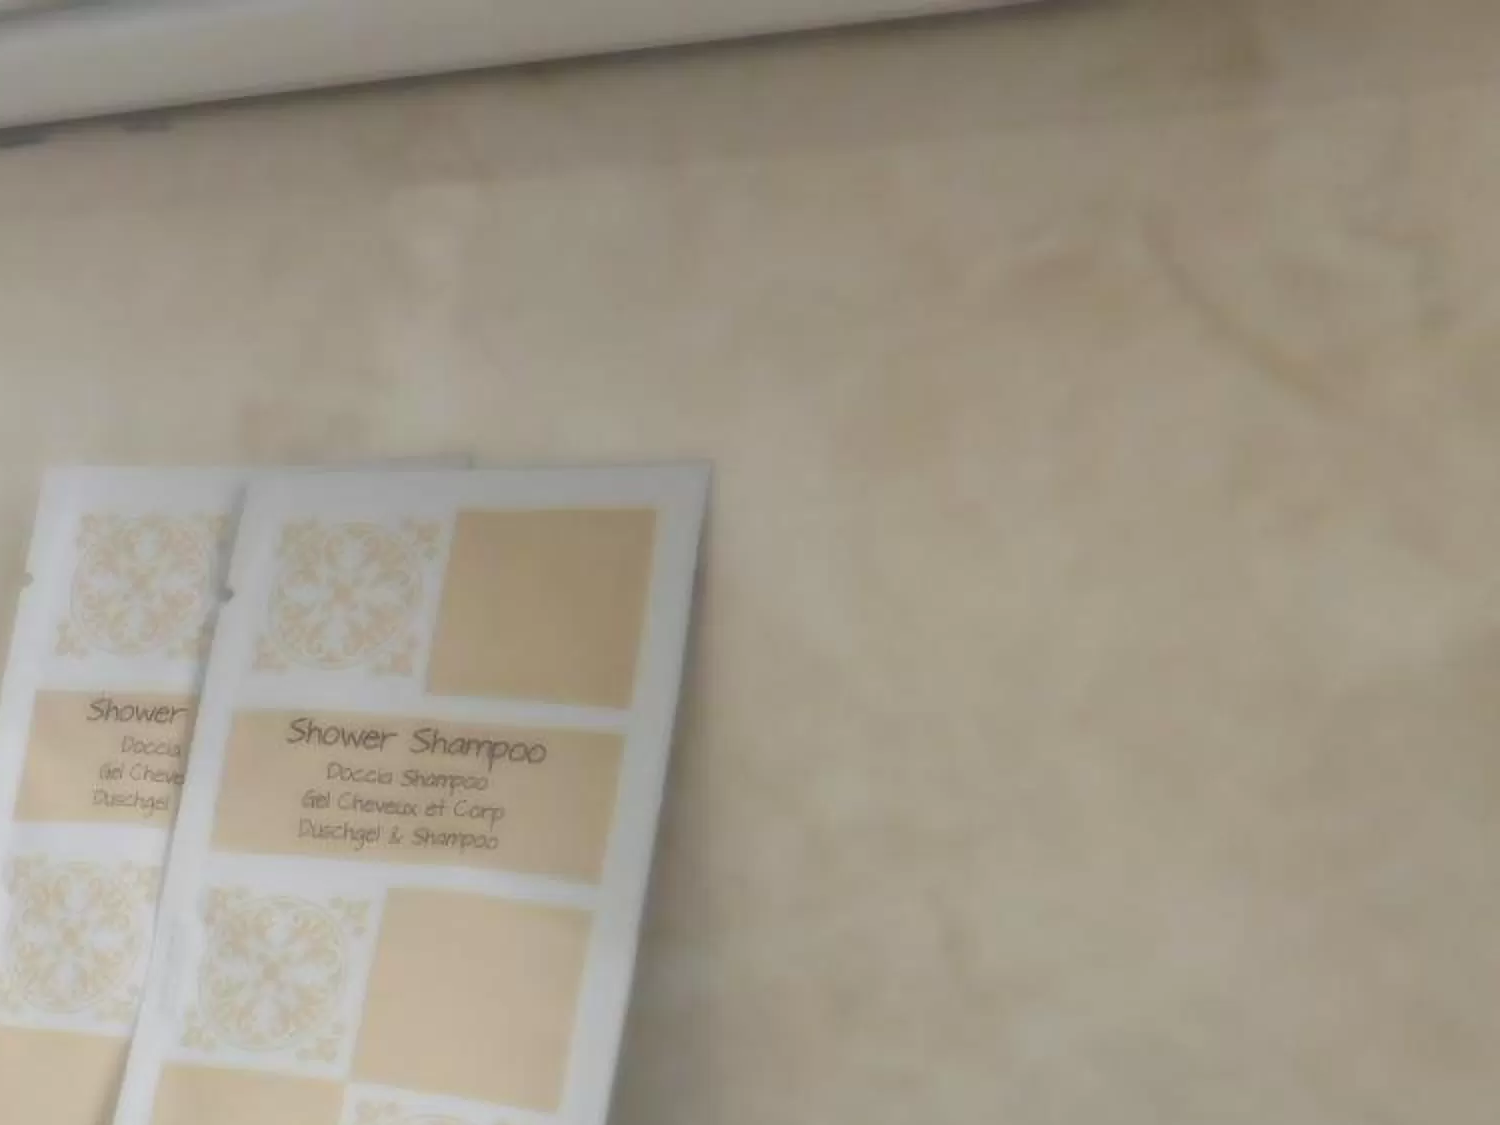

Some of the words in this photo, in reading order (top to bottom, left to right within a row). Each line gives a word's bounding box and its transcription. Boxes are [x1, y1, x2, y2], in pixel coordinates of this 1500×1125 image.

[86, 697, 188, 724] Shower
[121, 735, 181, 757] Doccia
[286, 717, 398, 751] Shower
[409, 727, 547, 772] Shampoo
[326, 762, 393, 785] Doccia
[400, 769, 489, 796] Shampoo
[301, 789, 331, 809] Gel
[338, 791, 418, 817] Cheveux
[424, 800, 446, 818] et
[453, 799, 505, 832] Corp
[297, 818, 381, 851] Duschgel
[387, 826, 404, 845] &
[411, 827, 499, 854] Shampoo
